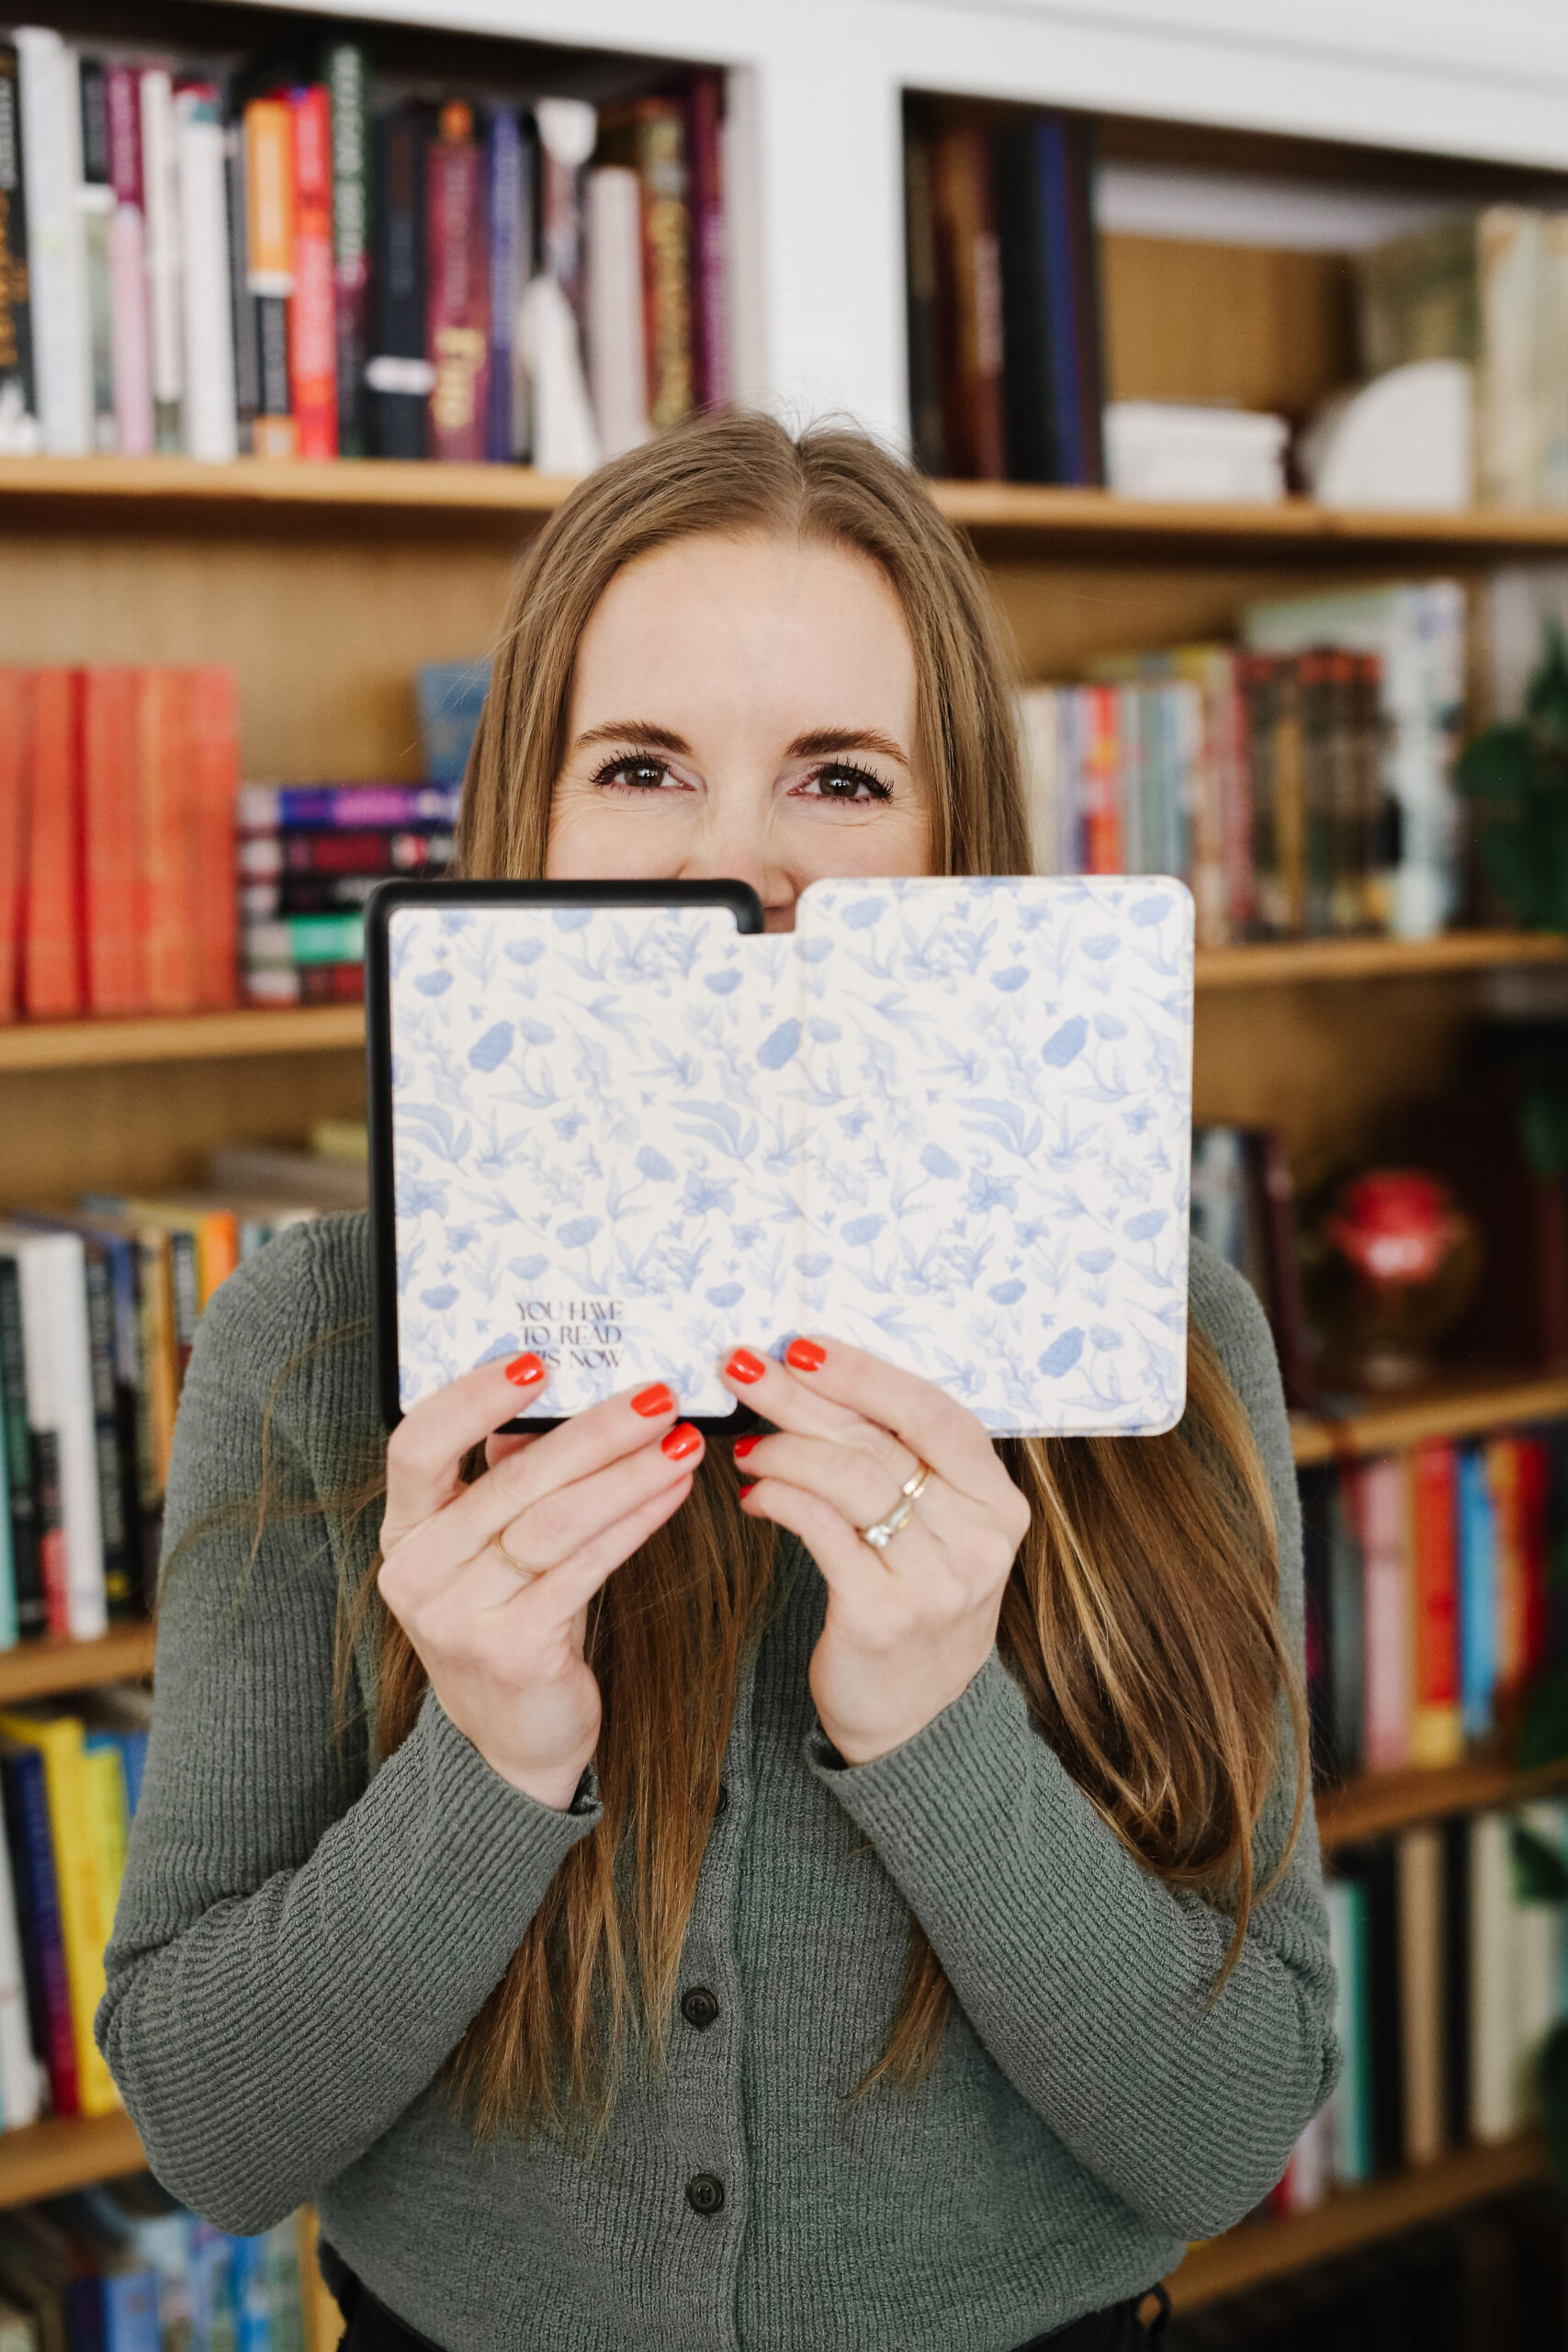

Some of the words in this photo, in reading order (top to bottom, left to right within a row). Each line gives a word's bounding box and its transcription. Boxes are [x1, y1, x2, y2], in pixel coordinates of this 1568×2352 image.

[516, 1301, 563, 1321] YOU
[569, 1301, 624, 1321] HAVE
[519, 1326, 551, 1346] TO
[559, 1326, 622, 1346] READ
[570, 1350, 624, 1369] NOW
